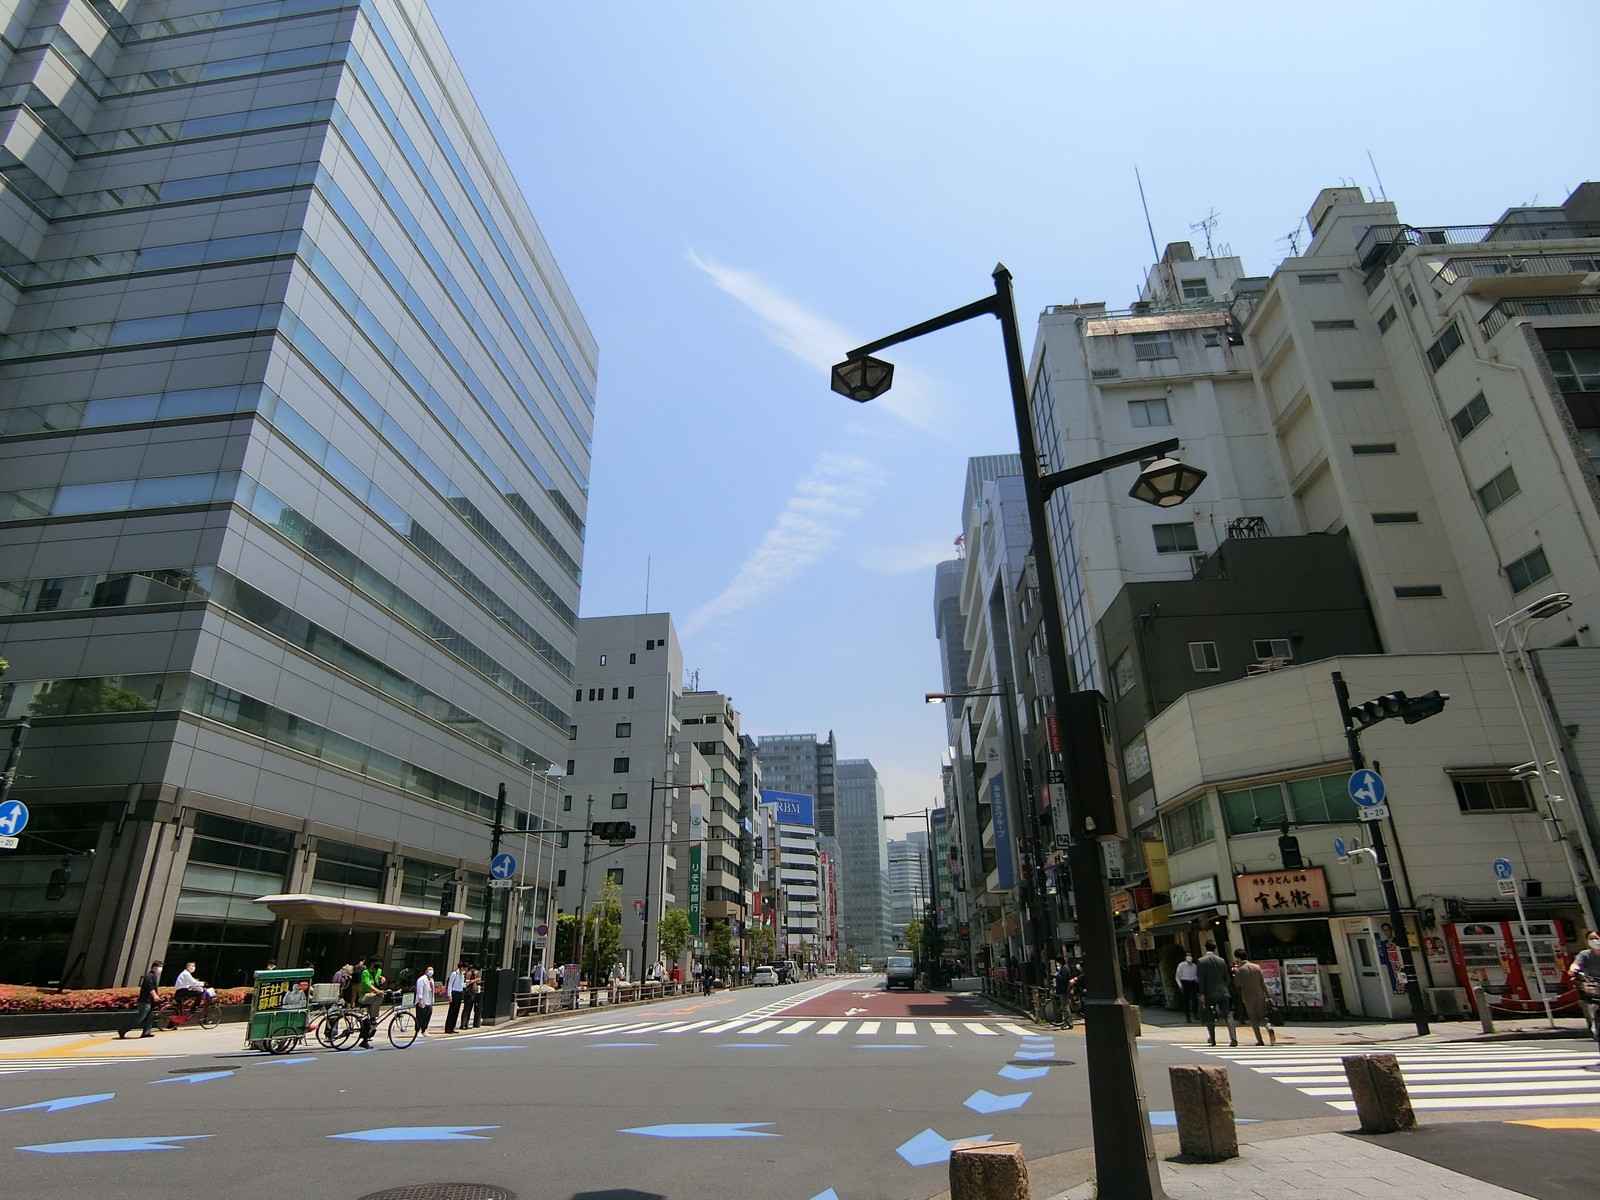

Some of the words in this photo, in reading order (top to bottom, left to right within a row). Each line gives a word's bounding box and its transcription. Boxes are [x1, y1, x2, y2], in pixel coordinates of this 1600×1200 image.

[778, 802, 800, 814] RBM
[690, 863, 700, 913] りそな銀行
[260, 981, 289, 998] 正社員
